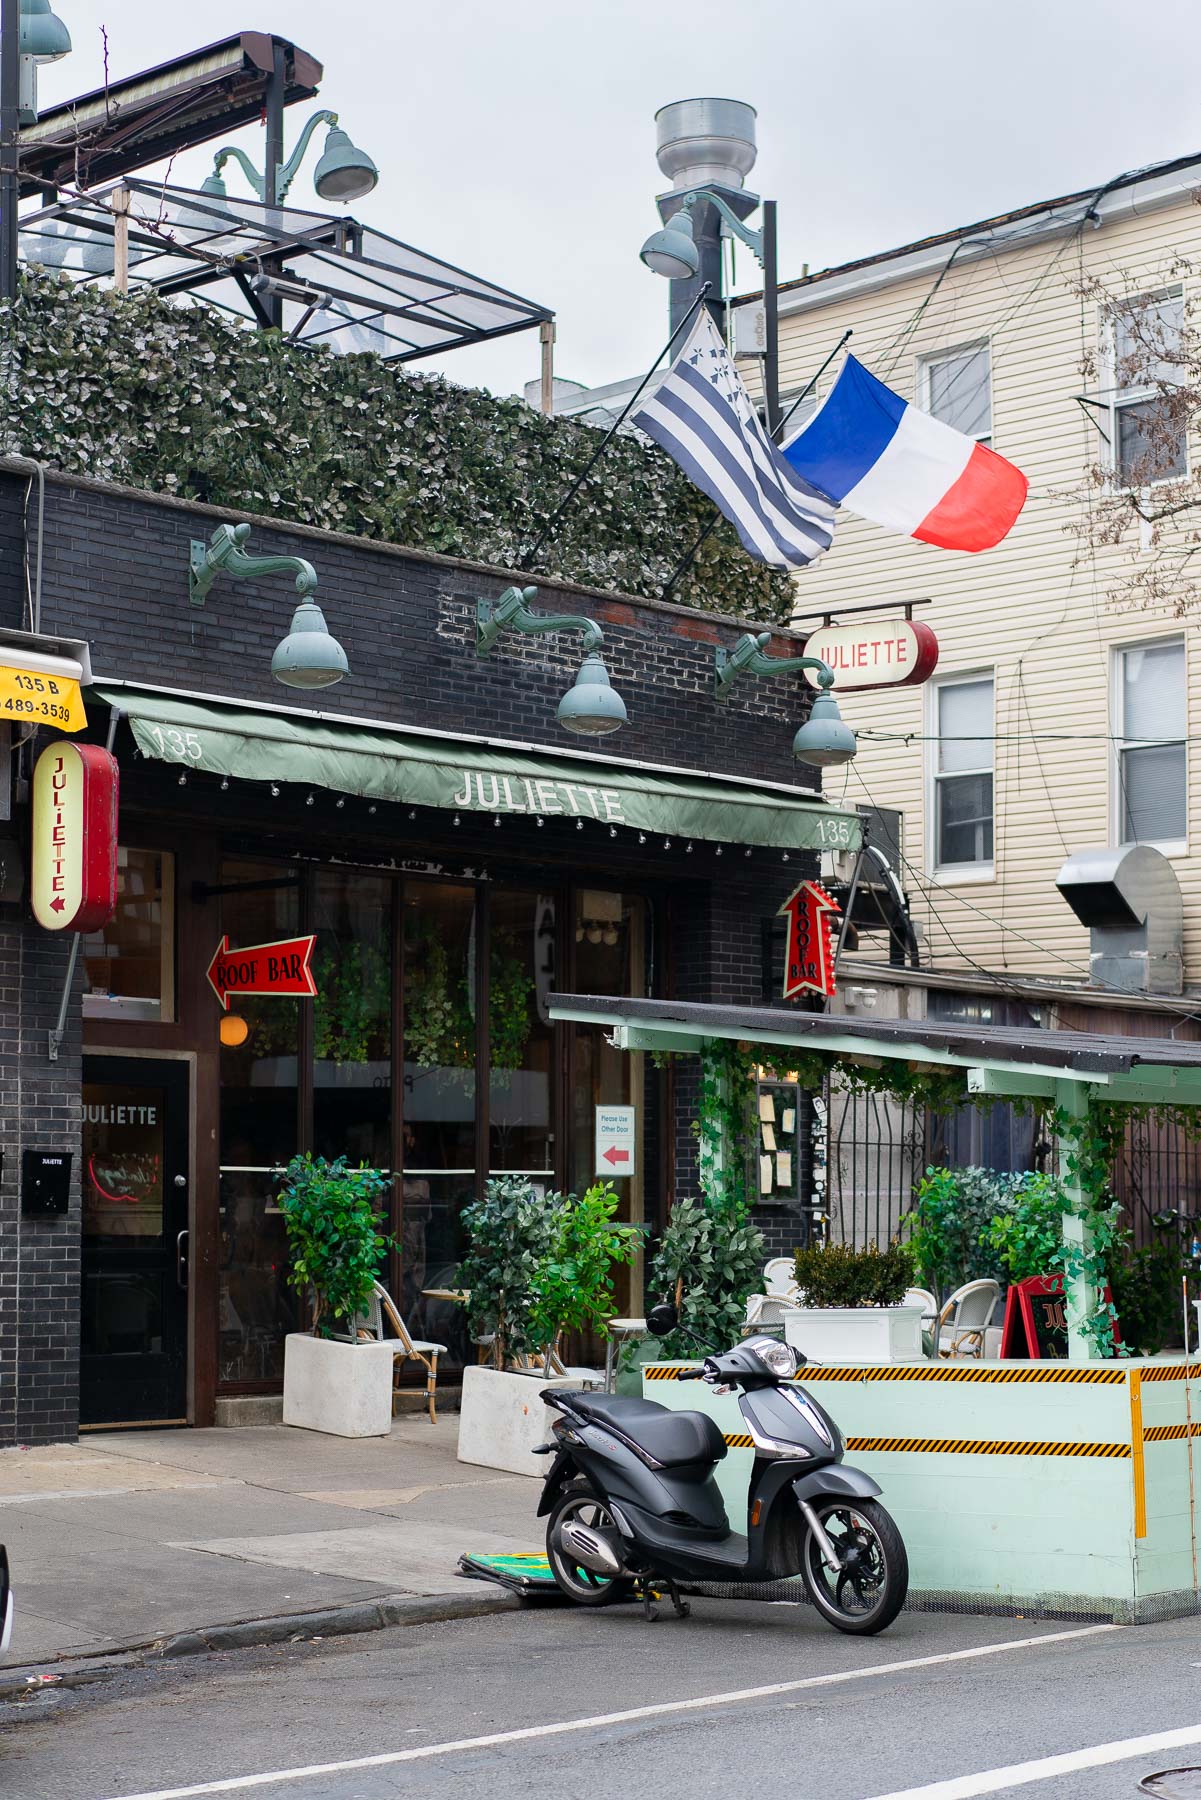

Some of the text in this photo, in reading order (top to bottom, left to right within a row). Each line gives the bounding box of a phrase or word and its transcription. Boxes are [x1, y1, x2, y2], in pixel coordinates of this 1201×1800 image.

[15, 675, 59, 694] 135 B
[4, 698, 70, 722] 489-3539
[151, 726, 203, 760] 135
[454, 771, 626, 822] JULIETTE
[816, 819, 850, 844] 135
[796, 901, 810, 963] ROOF
[217, 953, 303, 991] ROOF BAR
[790, 963, 818, 980] BAR
